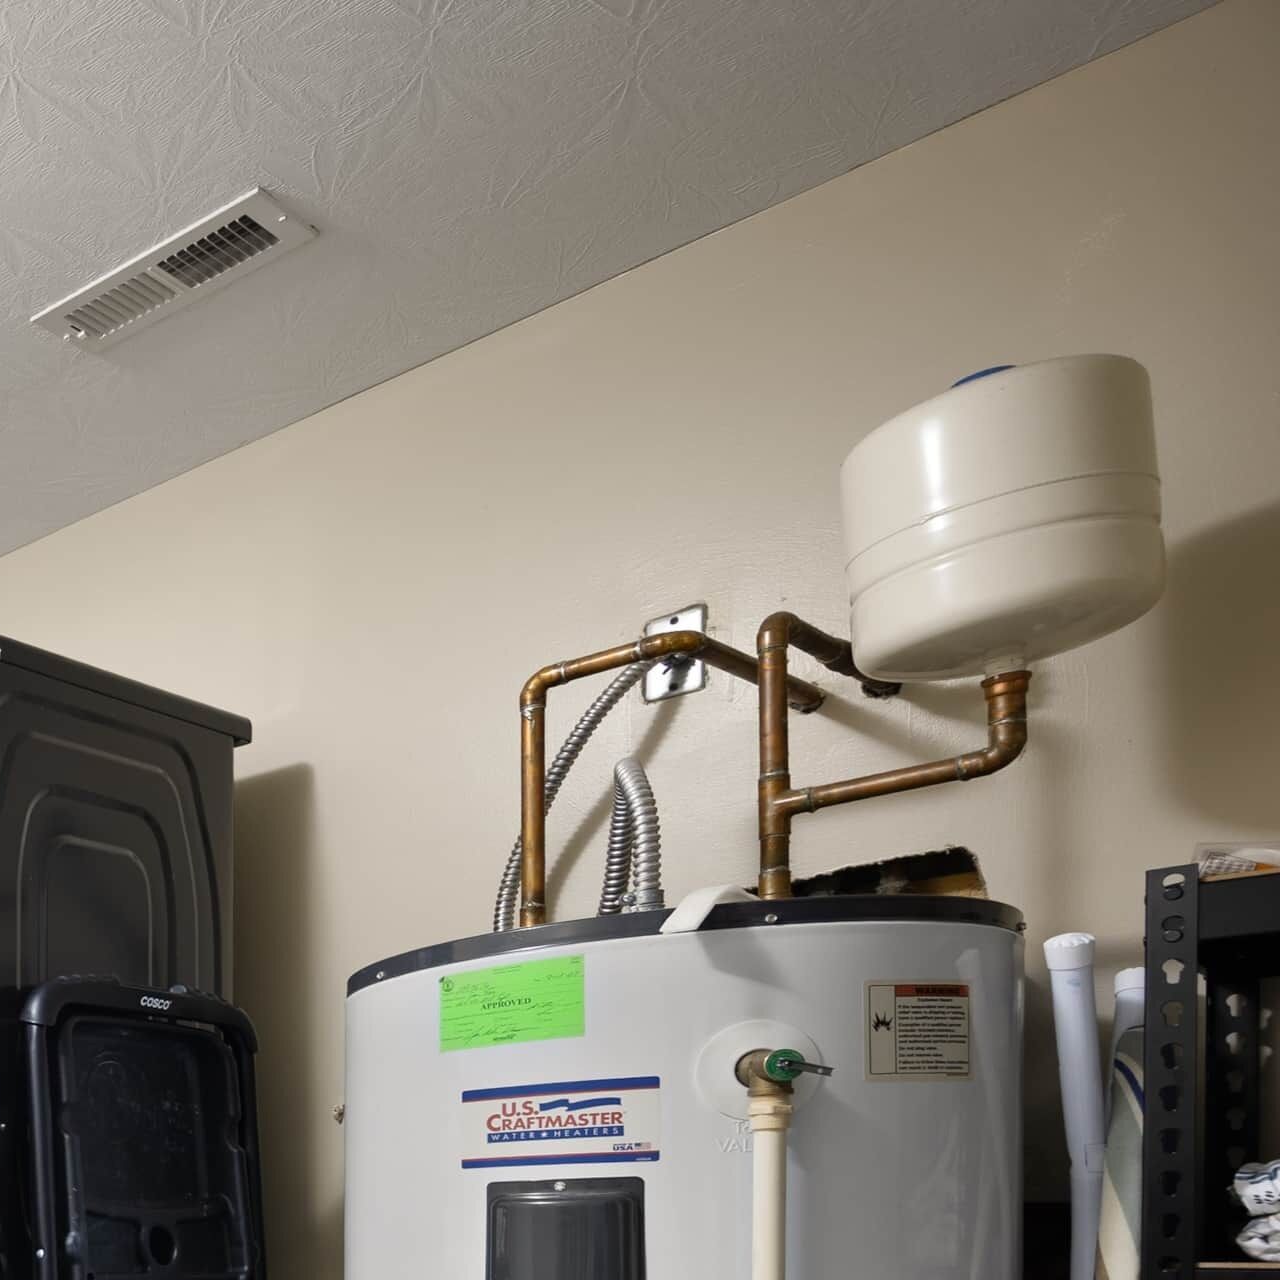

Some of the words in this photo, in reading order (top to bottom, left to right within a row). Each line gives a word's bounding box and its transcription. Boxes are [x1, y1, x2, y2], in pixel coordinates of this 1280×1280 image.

[140, 996, 170, 1010] COSCO
[481, 997, 532, 1011] APPROVED
[502, 1101, 539, 1117] U.S.
[486, 1112, 623, 1132] CRAFTMASTER
[491, 1132, 535, 1141] WATER
[554, 1127, 619, 1138] HEATERS
